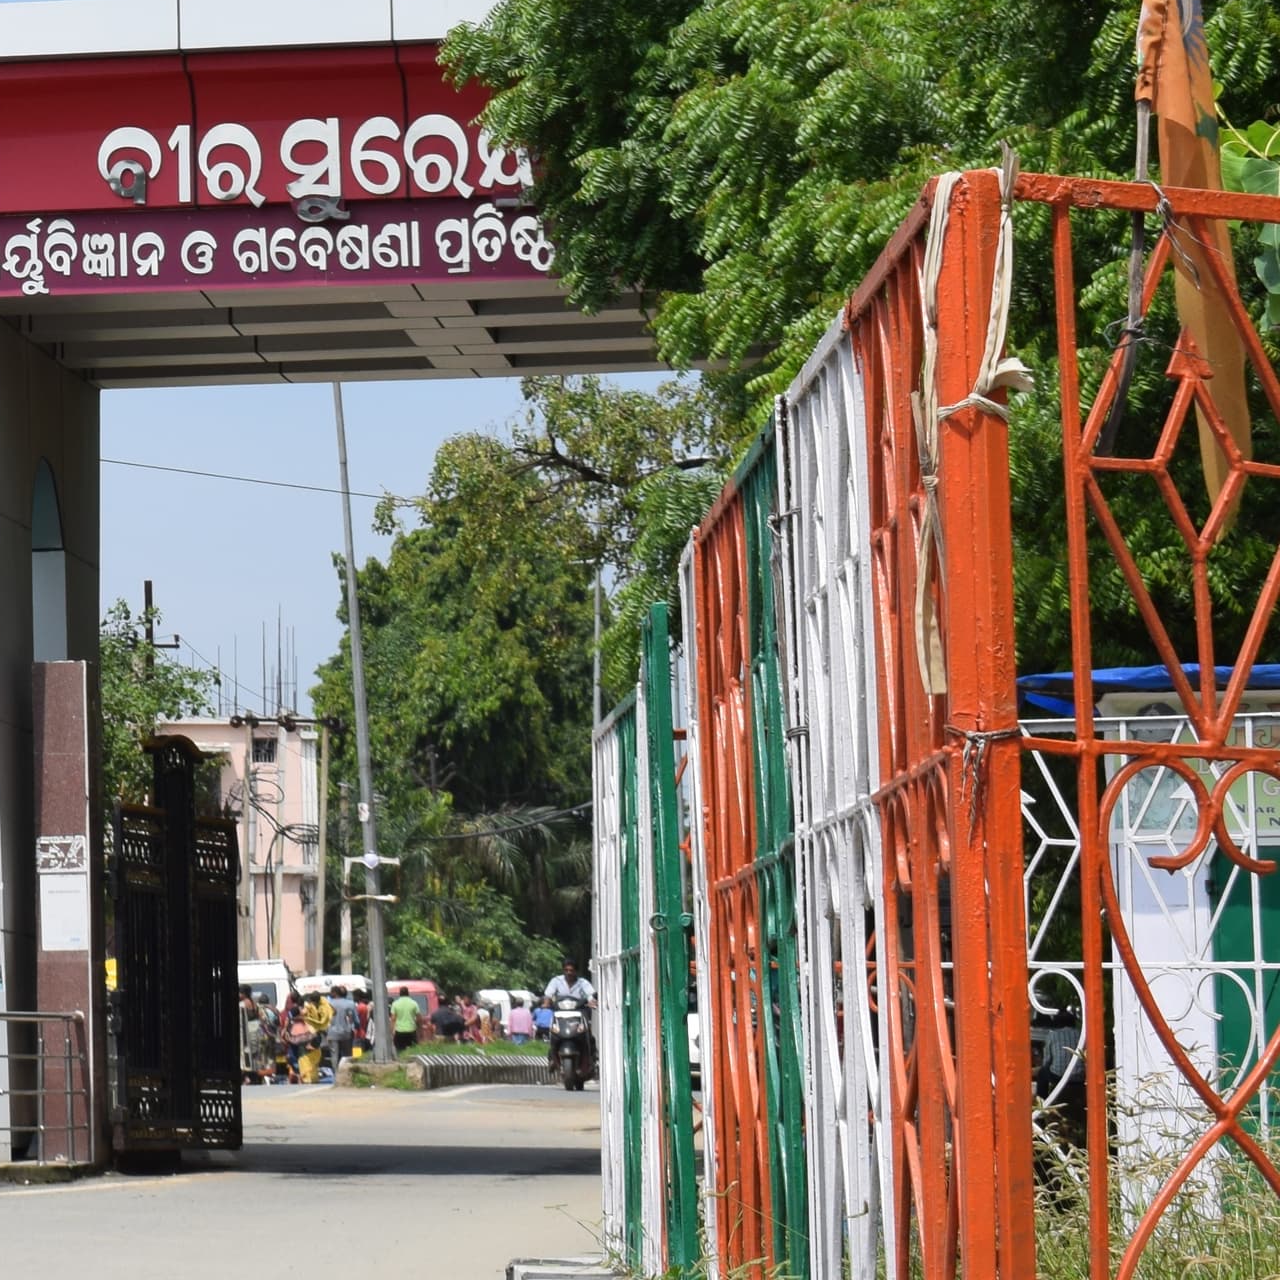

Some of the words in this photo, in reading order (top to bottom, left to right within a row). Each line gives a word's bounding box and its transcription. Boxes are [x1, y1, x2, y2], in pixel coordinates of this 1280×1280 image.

[97, 122, 266, 208] ବୀର
[180, 230, 218, 275] ଓ
[233, 220, 421, 274] ଗବେଷଣା
